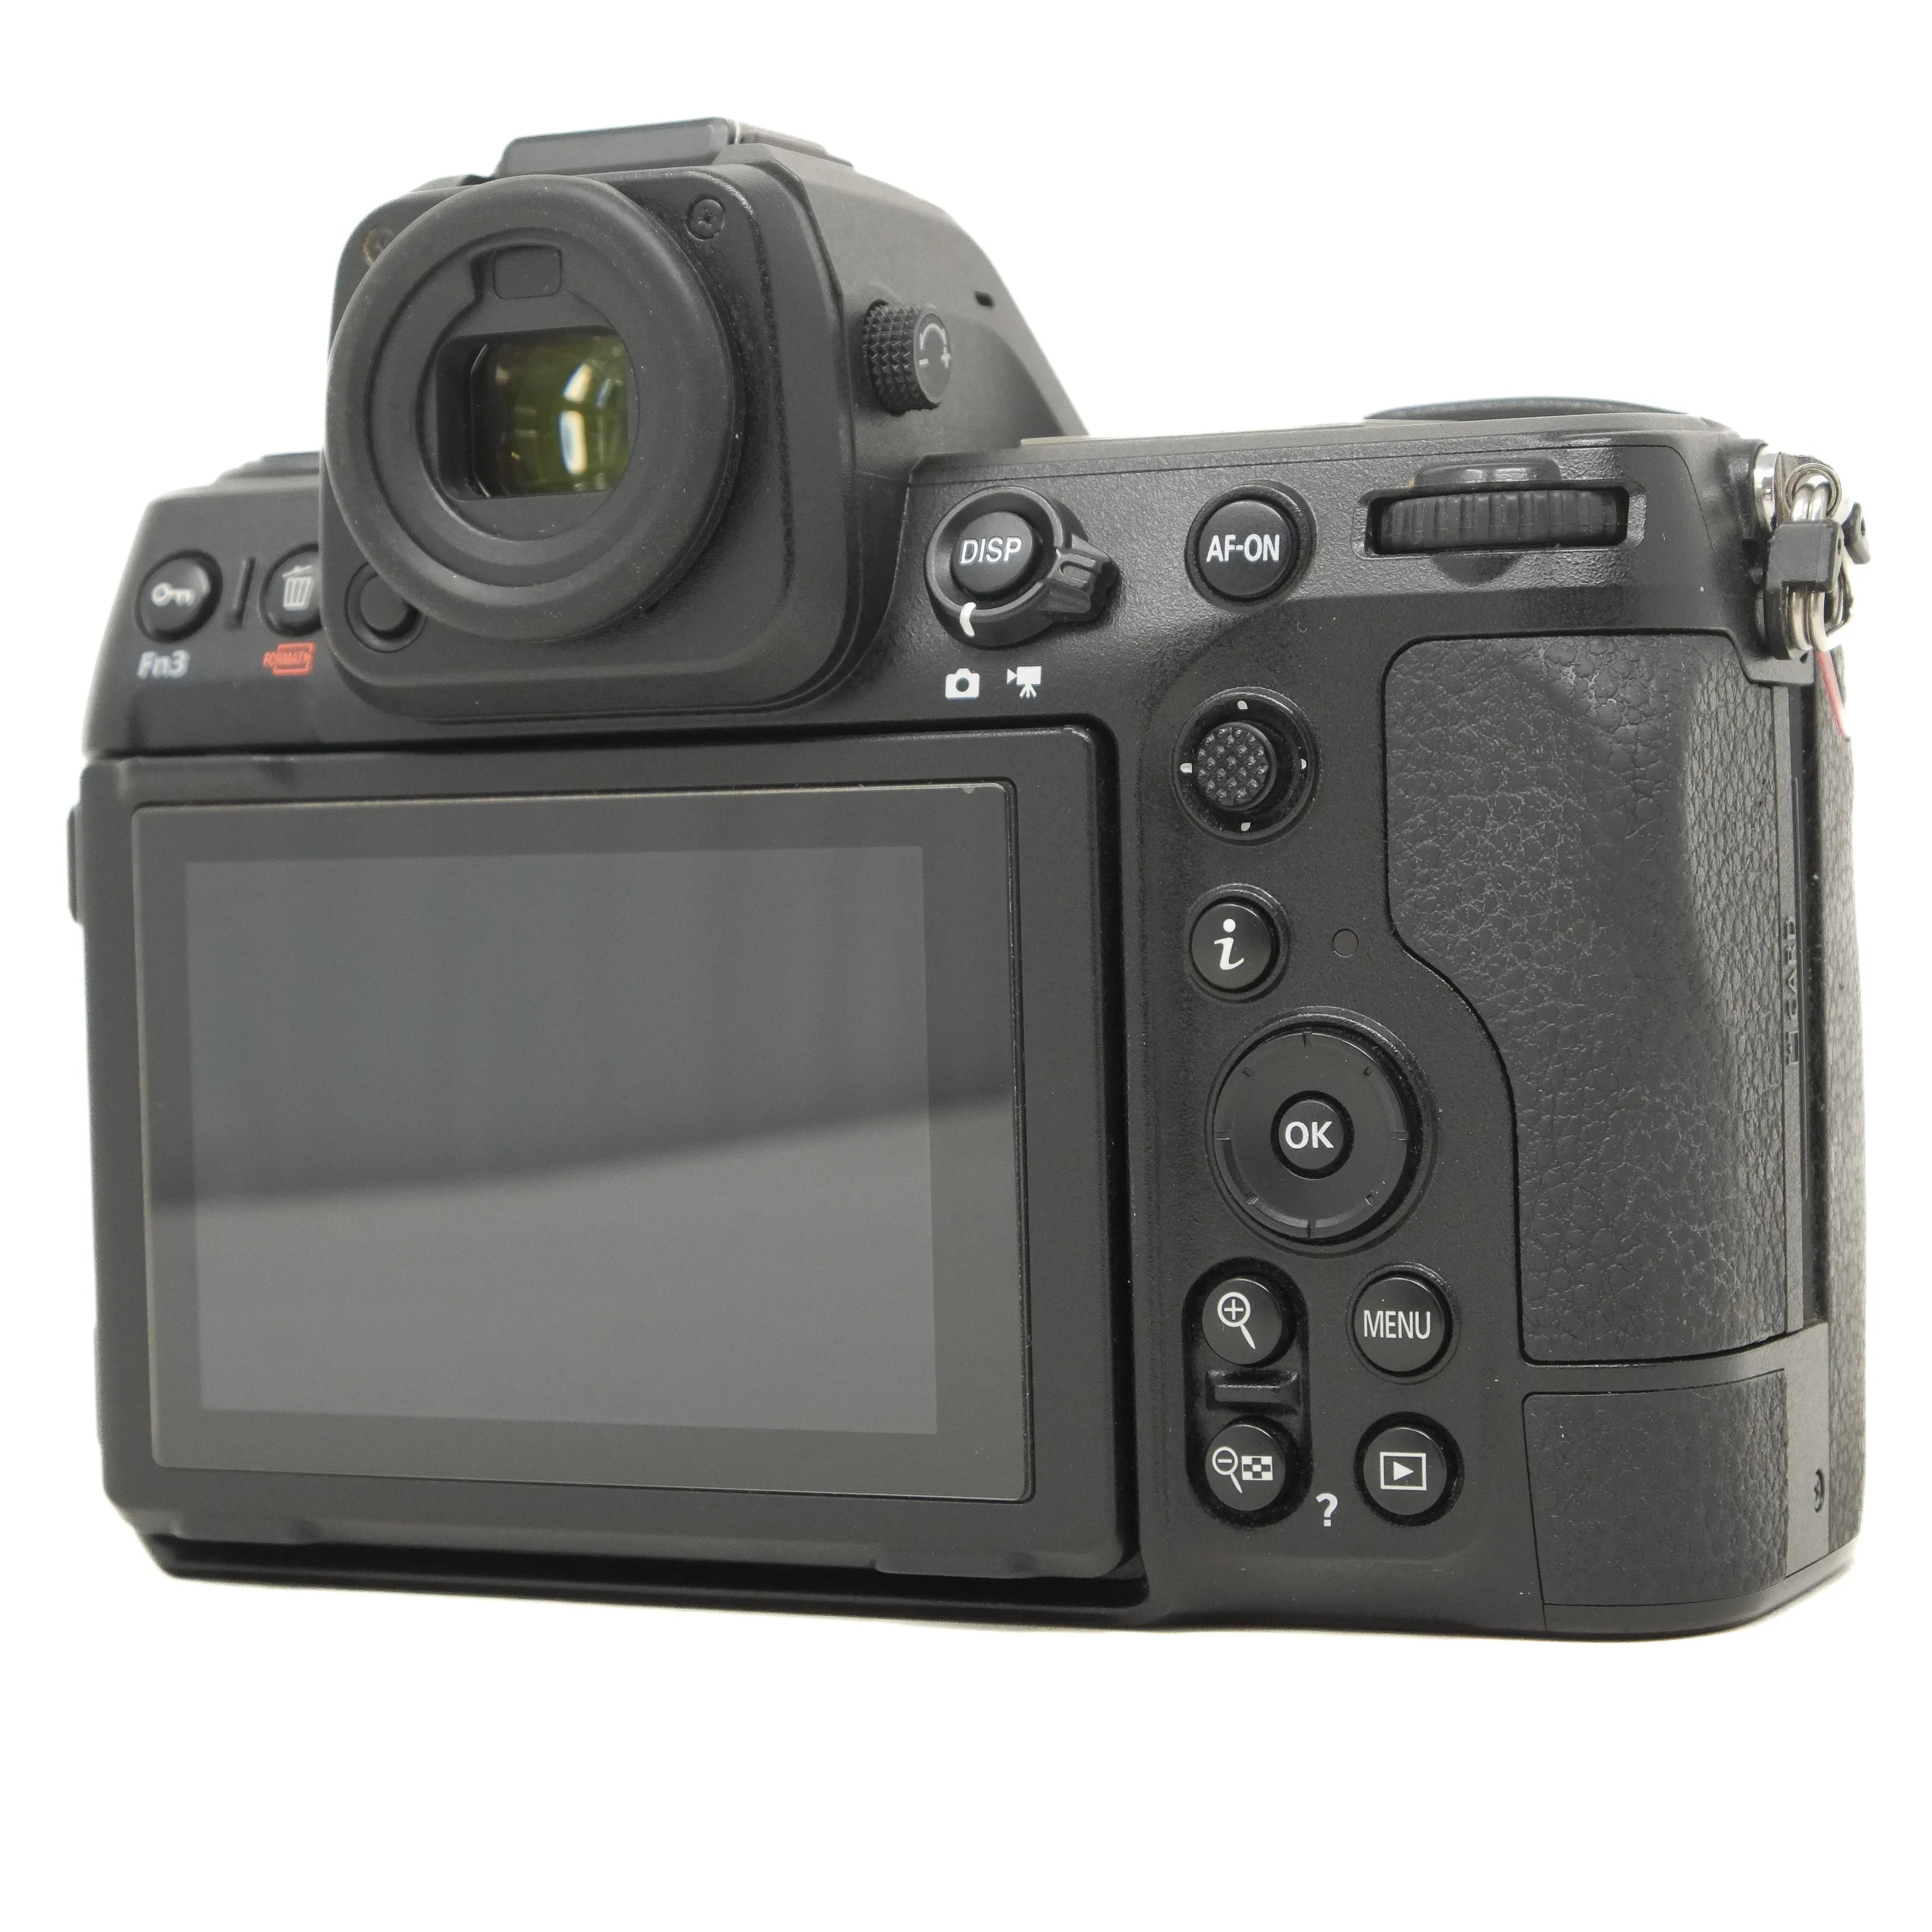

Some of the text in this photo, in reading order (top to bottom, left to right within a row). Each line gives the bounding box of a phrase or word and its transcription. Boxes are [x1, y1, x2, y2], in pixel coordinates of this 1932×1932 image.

[959, 536, 1022, 564] DISP
[1206, 533, 1280, 562] AF-ON
[137, 649, 191, 679] Fn3
[1213, 919, 1244, 970] i
[1783, 917, 1798, 1019] CARD
[1285, 1121, 1334, 1149] OK
[1364, 1310, 1431, 1339] MENU
